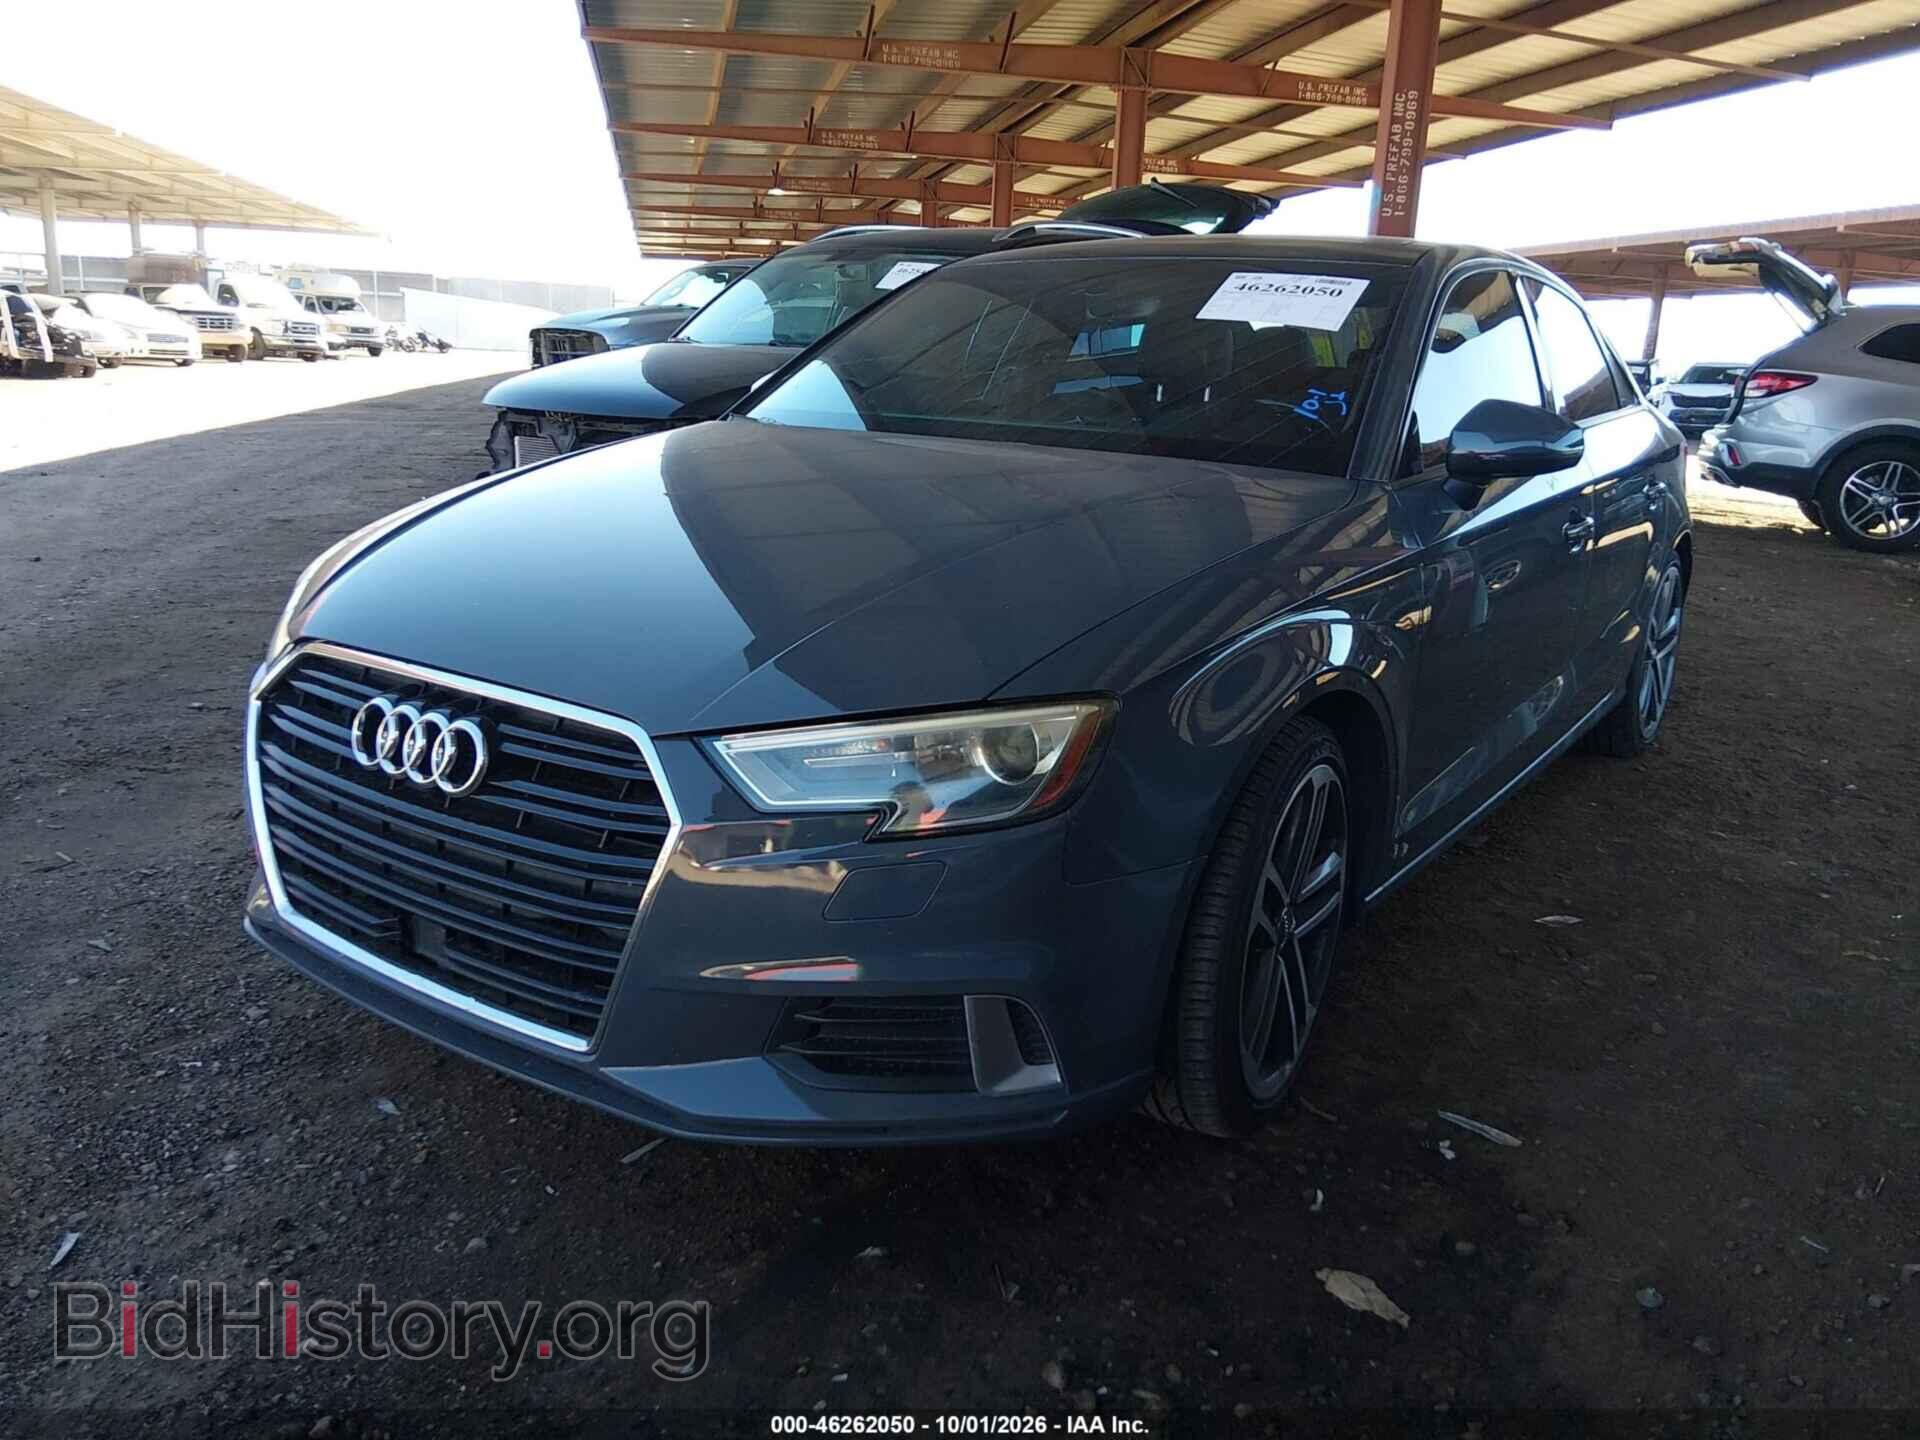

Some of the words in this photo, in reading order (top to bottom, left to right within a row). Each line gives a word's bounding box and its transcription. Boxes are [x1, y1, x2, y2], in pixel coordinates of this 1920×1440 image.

[1392, 88, 1408, 117] INC.
[1385, 122, 1403, 181] PREFAB
[1394, 90, 1419, 216] 1-866-799-0969
[1381, 189, 1394, 217] U.S.
[1234, 282, 1344, 298] 46262050
